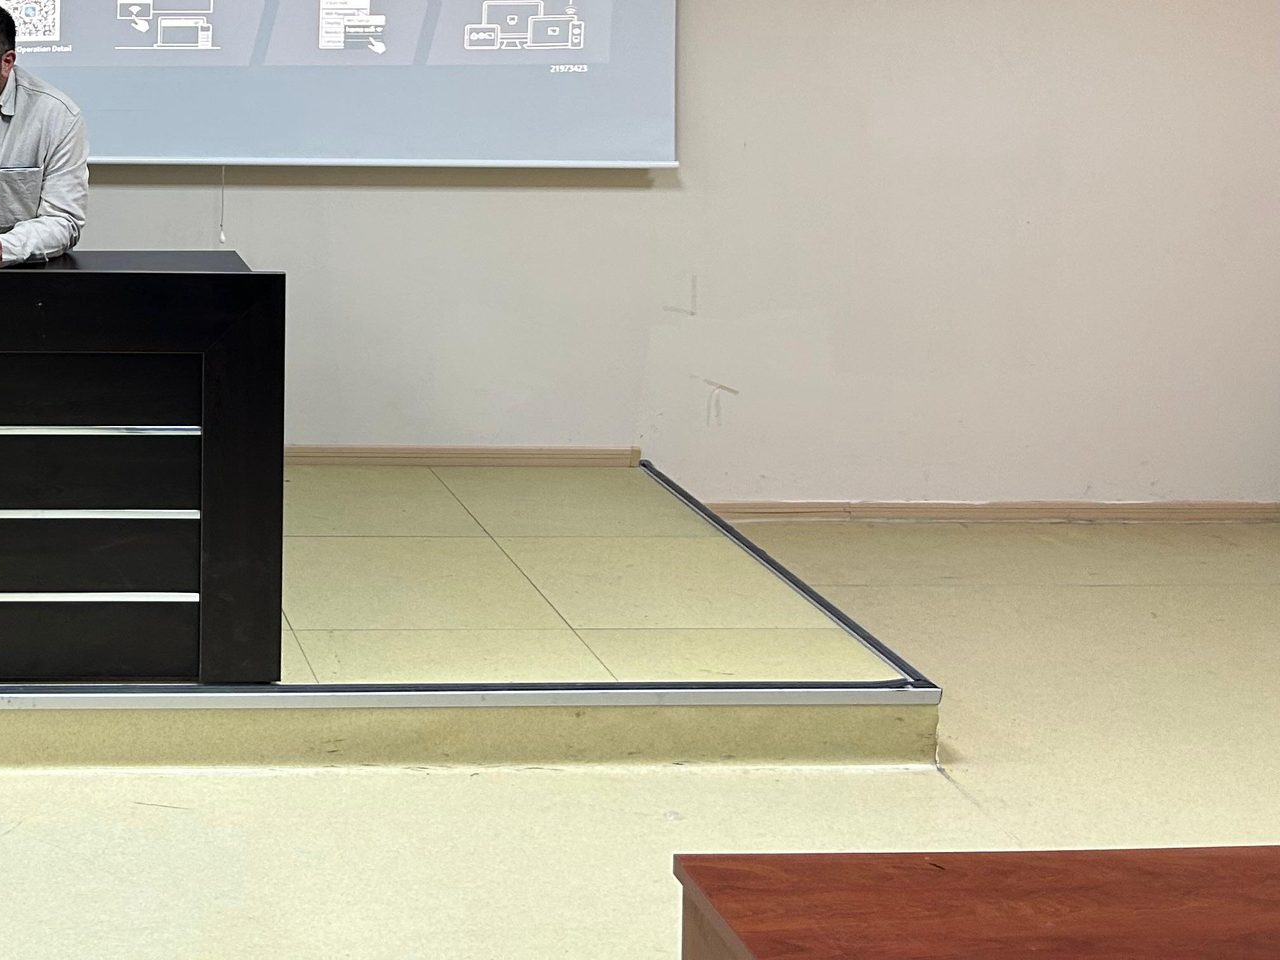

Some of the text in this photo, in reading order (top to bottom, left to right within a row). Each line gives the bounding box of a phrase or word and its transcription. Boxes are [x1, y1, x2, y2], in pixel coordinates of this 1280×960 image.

[16, 44, 73, 54] Operation Detail
[549, 64, 588, 73] 21973423
